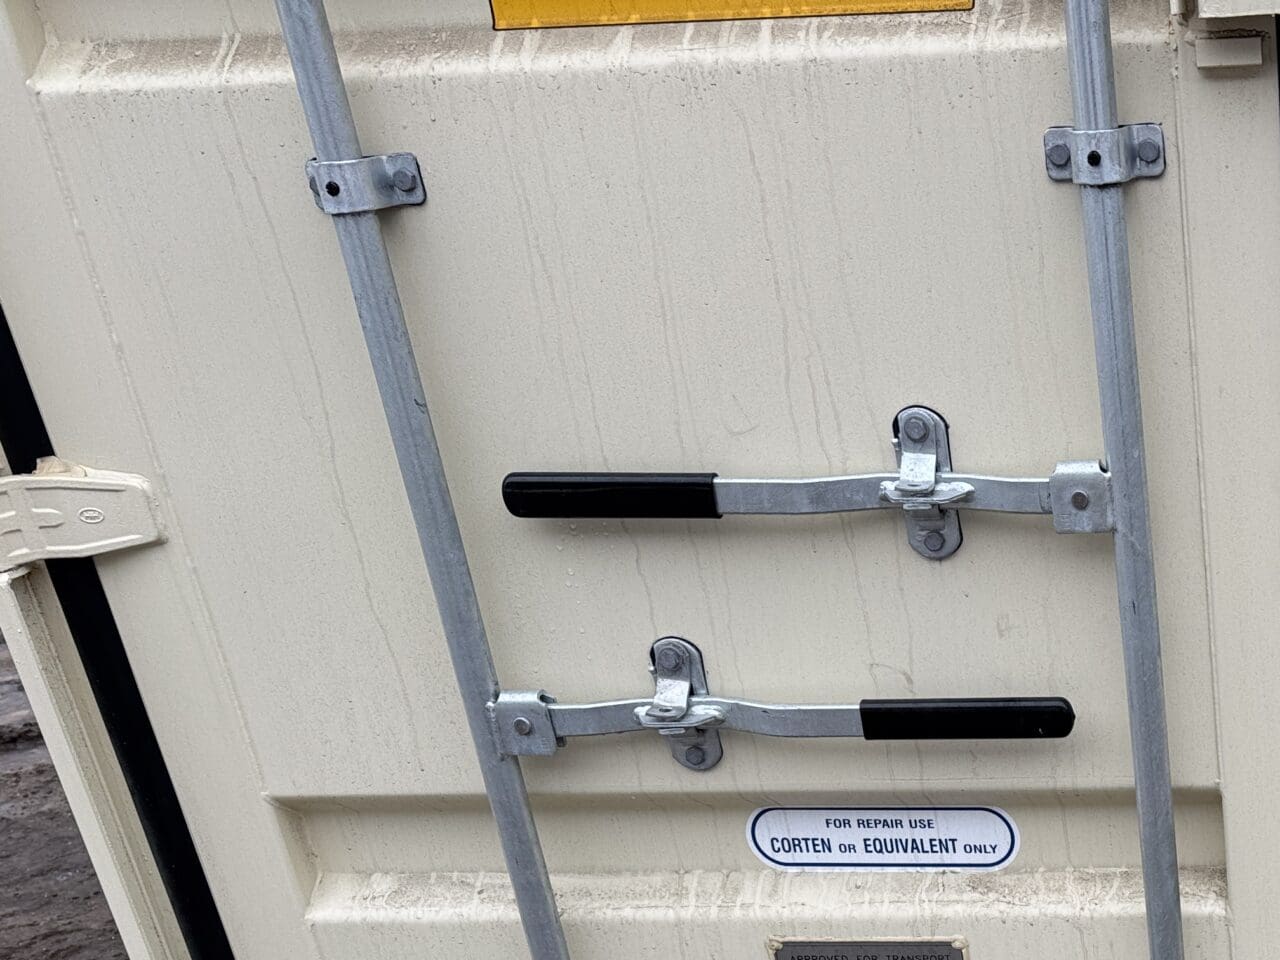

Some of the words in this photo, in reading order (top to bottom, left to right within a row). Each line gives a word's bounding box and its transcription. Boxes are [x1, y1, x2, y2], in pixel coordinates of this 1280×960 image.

[825, 818, 852, 829] FOR
[856, 818, 904, 829] REPAIR
[909, 819, 935, 829] USE
[770, 837, 832, 854] CORTEN
[838, 843, 857, 854] OR
[863, 838, 958, 855] EQUIVALENT
[963, 843, 998, 854] ONLY
